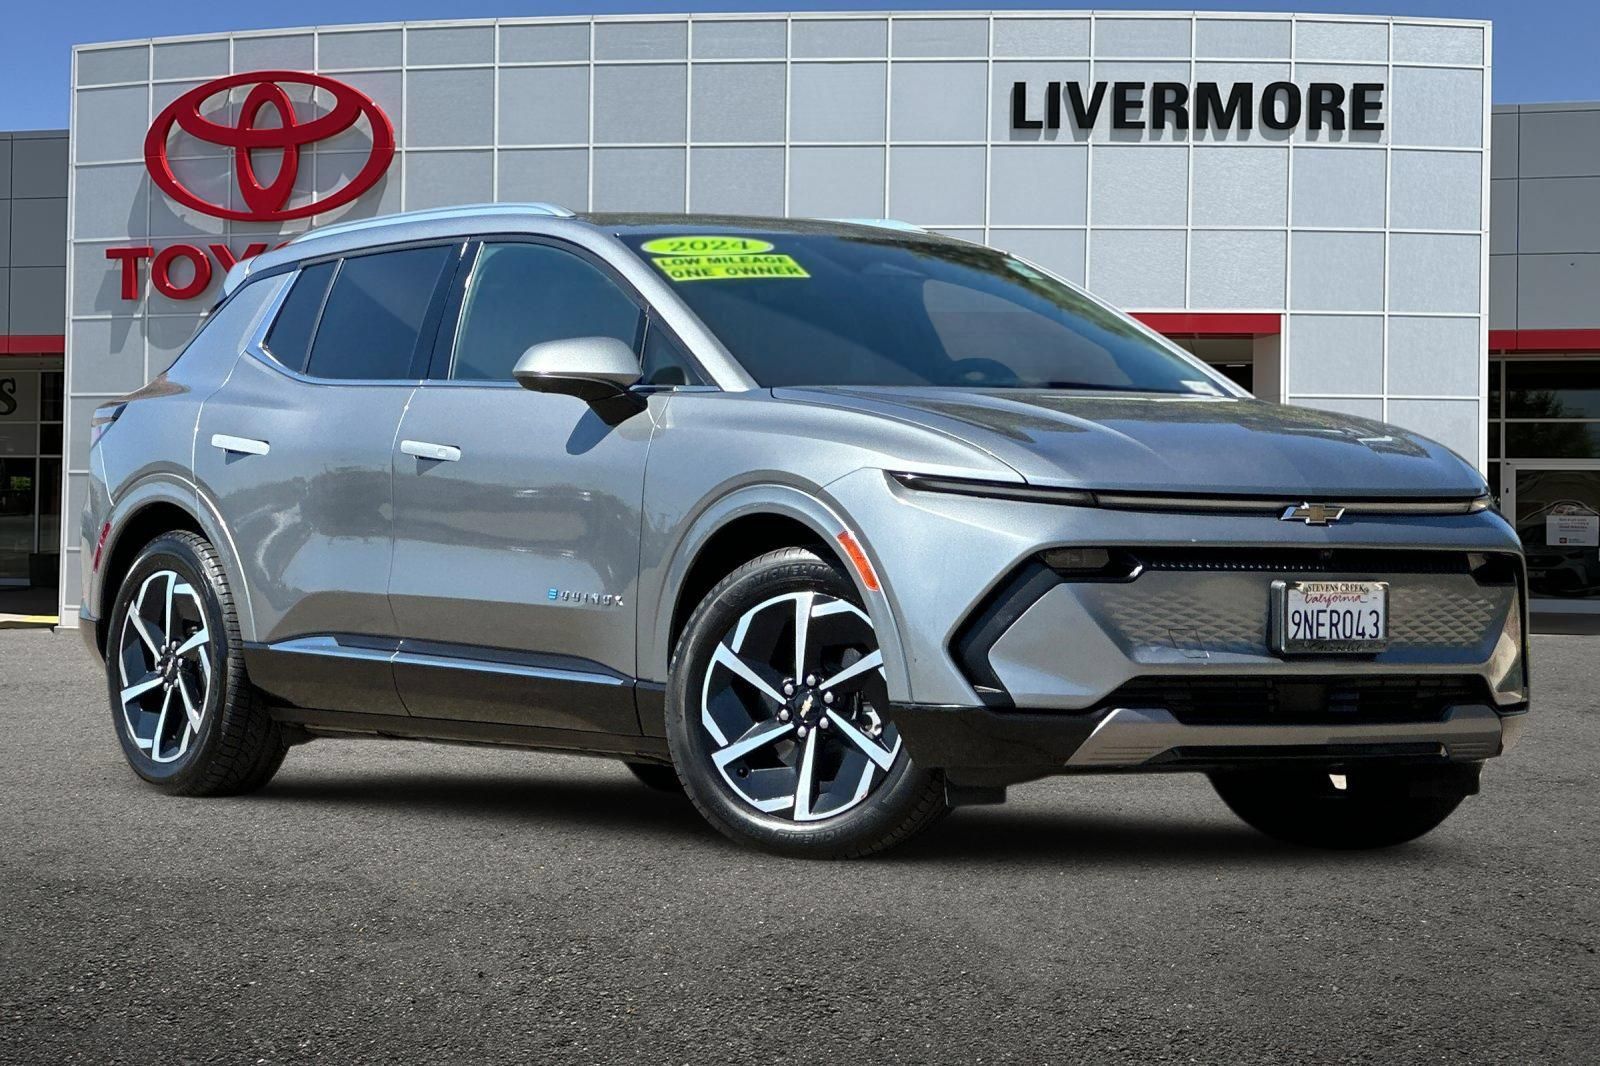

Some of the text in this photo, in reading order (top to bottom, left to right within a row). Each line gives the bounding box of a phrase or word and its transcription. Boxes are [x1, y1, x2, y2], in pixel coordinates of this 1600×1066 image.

[1012, 81, 1385, 131] LIVERMORE
[668, 239, 751, 252] 2024
[660, 255, 790, 267] LOW MILEAGE
[671, 266, 801, 279] ONE OWNER
[1307, 583, 1365, 592] STEVENS CREEK
[548, 588, 624, 606] EQUINOX
[1304, 593, 1368, 608] California
[1291, 609, 1380, 640] 9NER043
